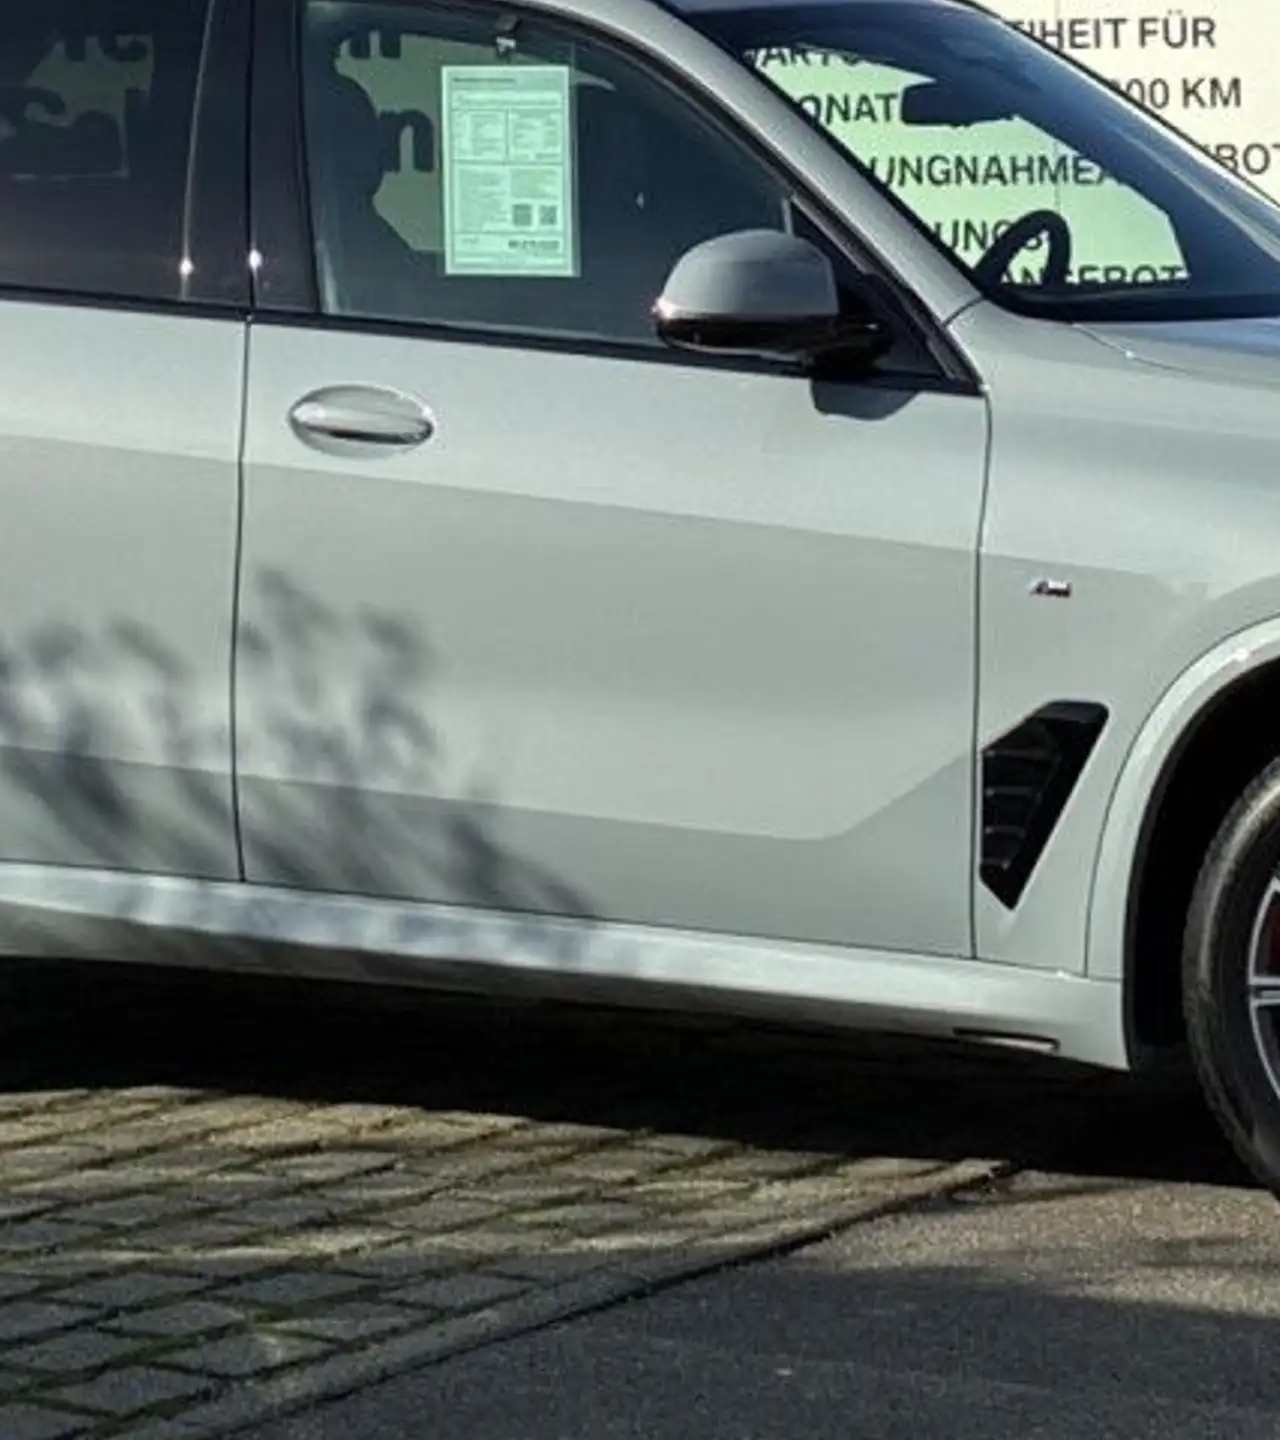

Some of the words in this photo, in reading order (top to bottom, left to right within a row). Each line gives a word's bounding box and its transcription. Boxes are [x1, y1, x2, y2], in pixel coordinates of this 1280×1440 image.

[1139, 9, 1216, 51] FÜR
[799, 92, 897, 124] ONAT
[1182, 77, 1241, 109] KM
